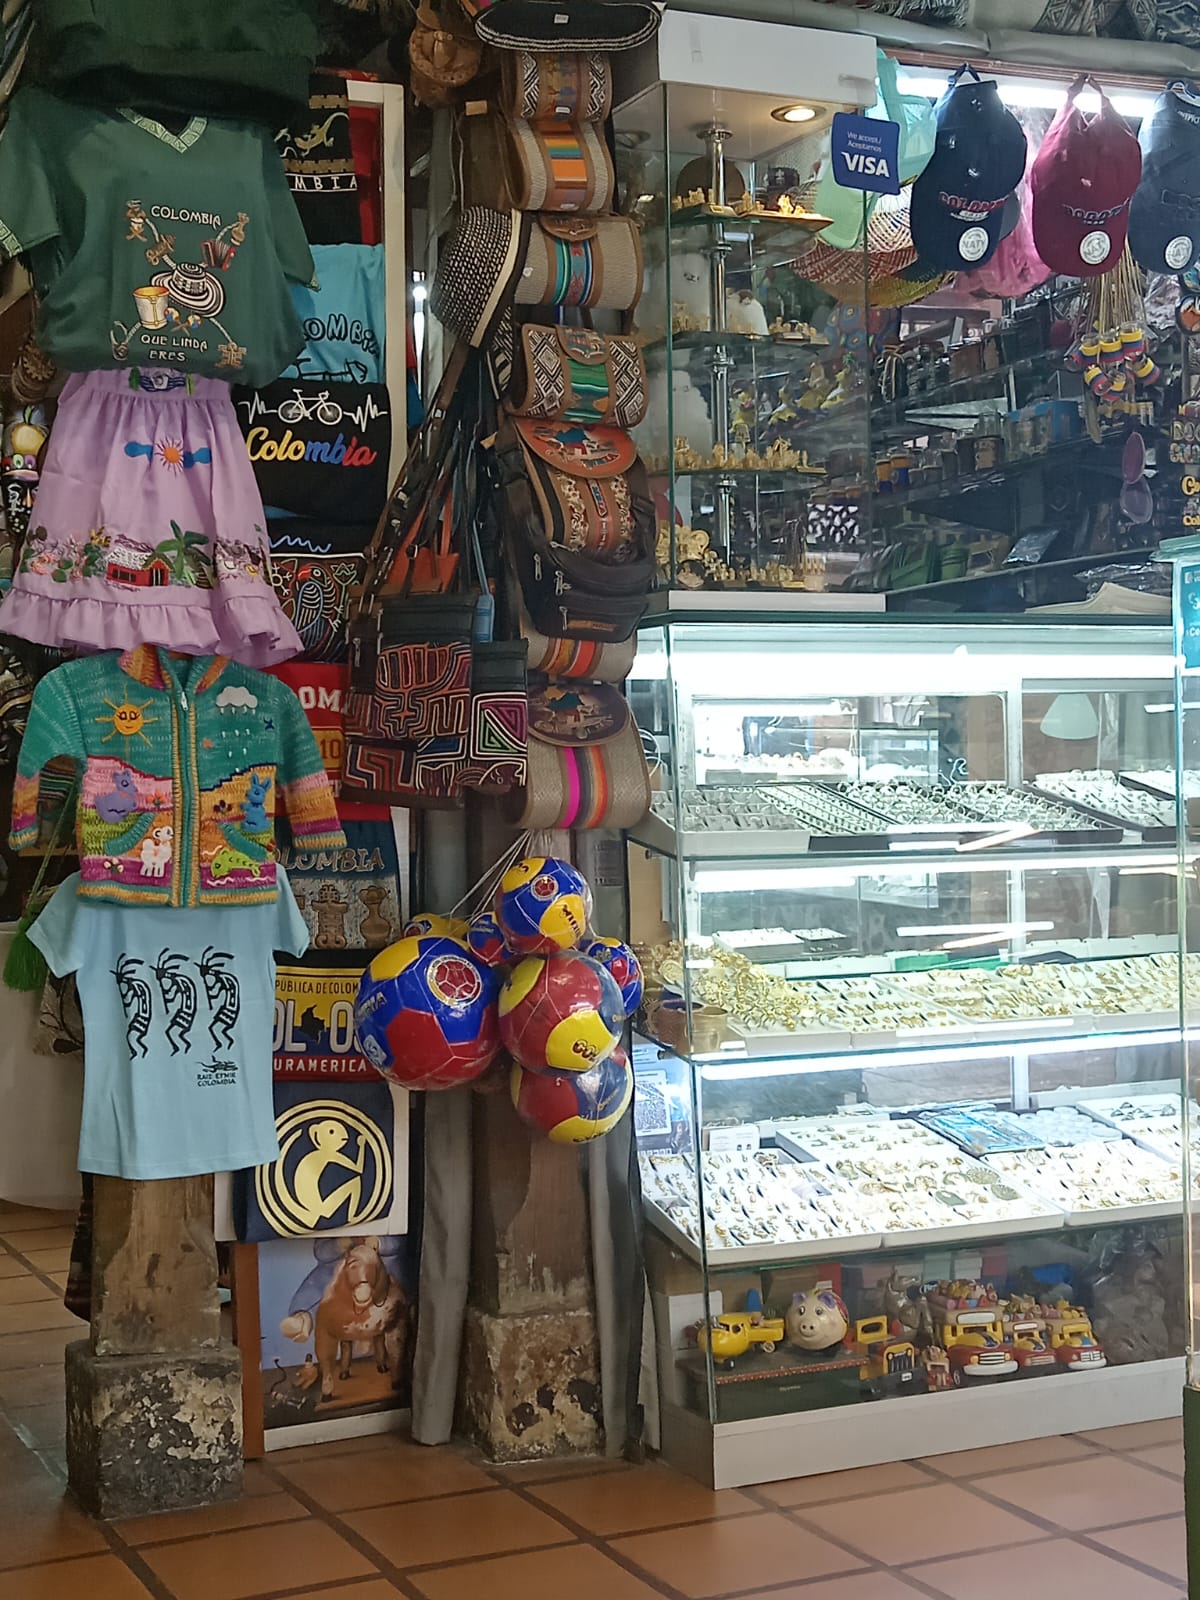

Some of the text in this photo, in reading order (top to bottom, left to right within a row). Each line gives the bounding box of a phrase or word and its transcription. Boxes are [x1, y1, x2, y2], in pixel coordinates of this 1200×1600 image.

[840, 151, 890, 178] VISA
[151, 205, 222, 230] COLOMBIA
[141, 334, 208, 352] QUE LINDA
[149, 349, 186, 361] ERES
[246, 426, 378, 467] Colombia
[315, 982, 327, 994] DE
